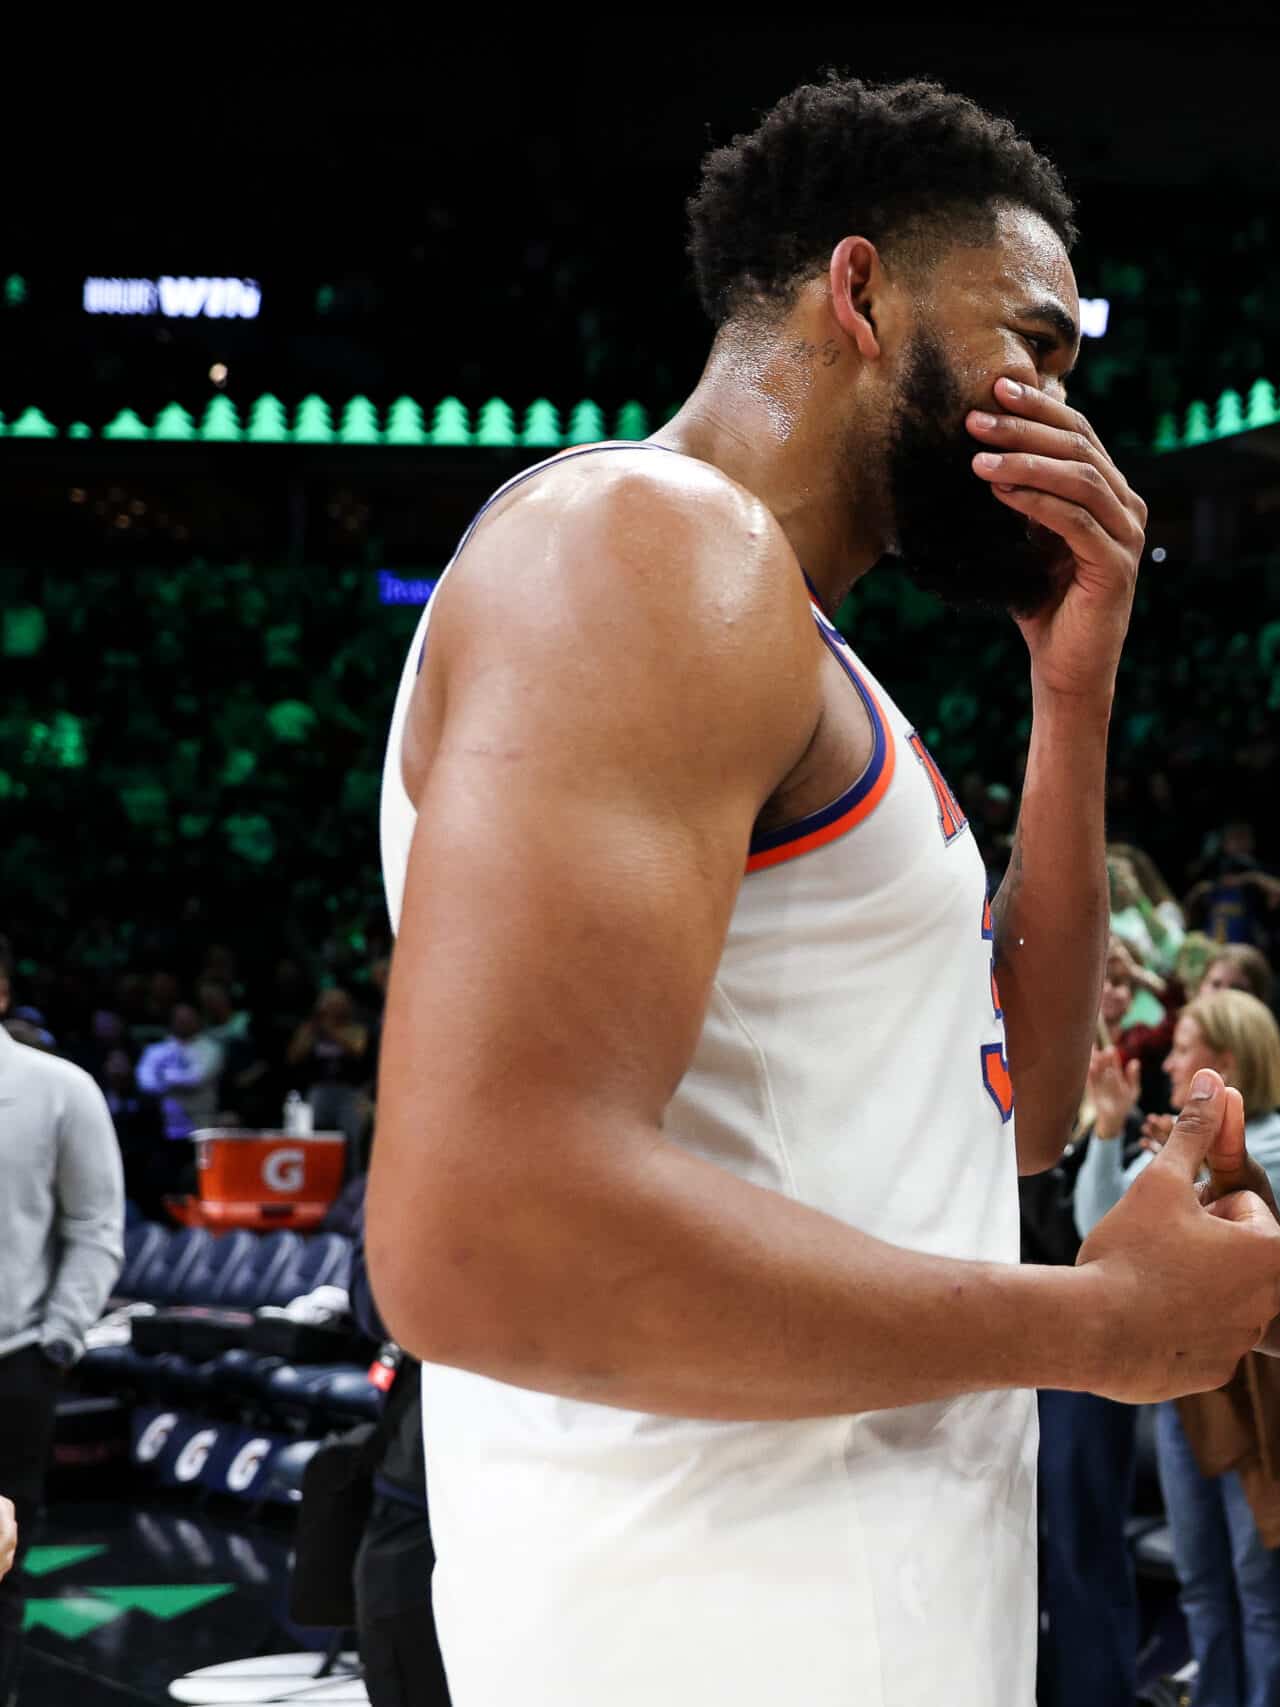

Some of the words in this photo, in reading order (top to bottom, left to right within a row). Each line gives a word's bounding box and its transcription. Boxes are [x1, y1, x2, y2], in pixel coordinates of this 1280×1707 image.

[262, 1147, 305, 1194] G
[174, 1429, 218, 1482] G
[226, 1438, 272, 1492] G
